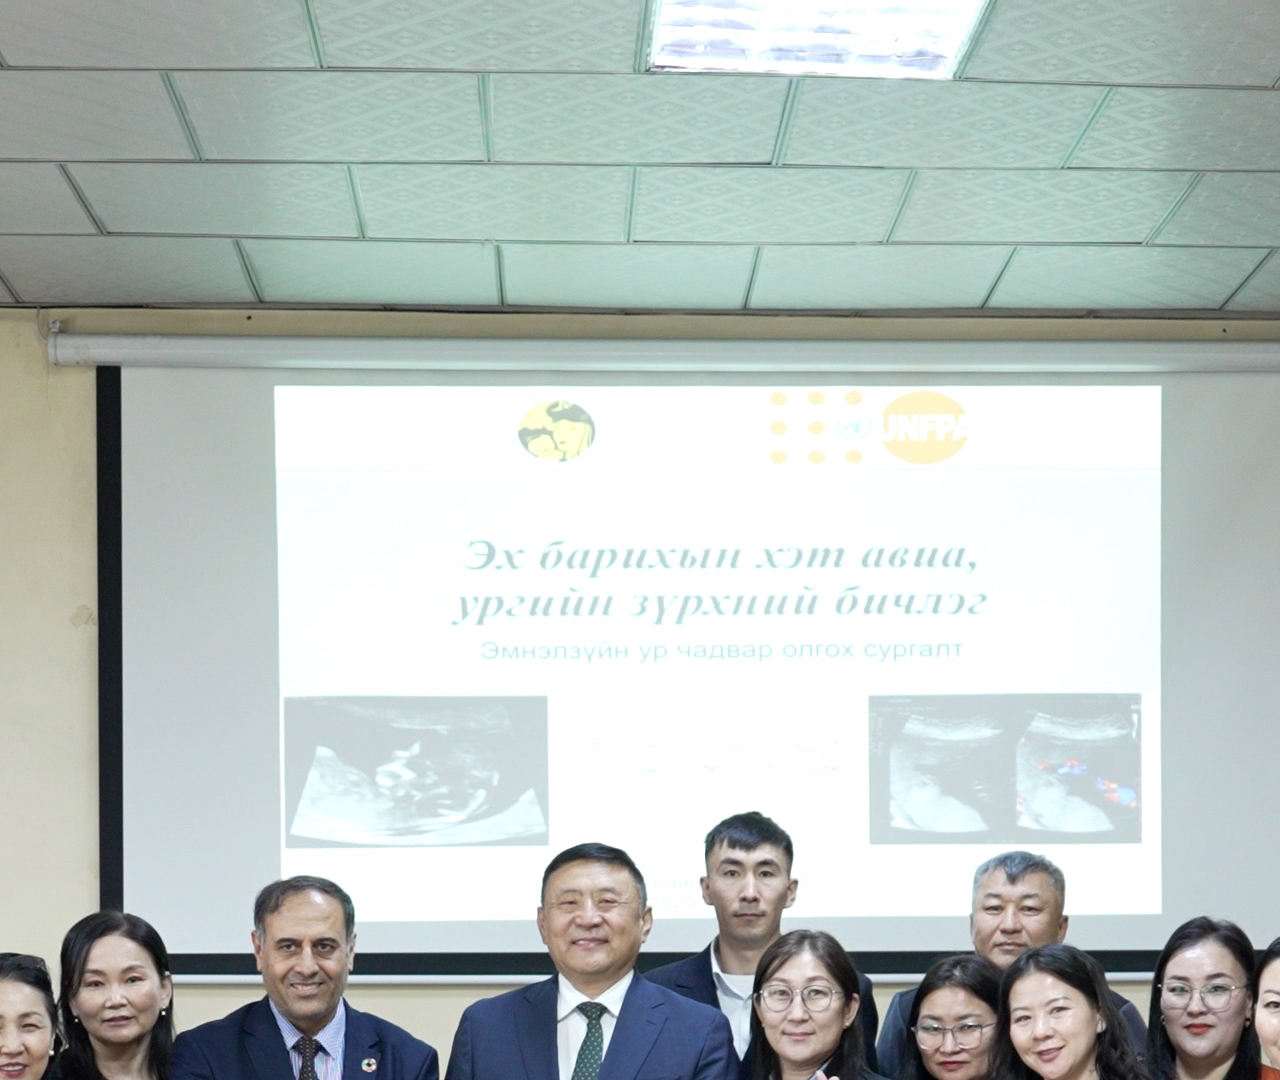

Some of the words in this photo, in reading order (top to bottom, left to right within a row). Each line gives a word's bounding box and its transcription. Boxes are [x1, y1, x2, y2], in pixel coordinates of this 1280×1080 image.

[880, 413, 968, 441] UNFPA
[463, 540, 525, 570] Эх
[540, 540, 742, 578] барихын
[754, 547, 846, 569] хэт
[861, 547, 977, 574] авиа,
[451, 587, 614, 626] ургийн
[629, 585, 820, 625] зүрхний
[834, 585, 988, 616] бичлэг
[480, 641, 629, 663] Эмнэлзүйн
[638, 644, 668, 663] ур
[677, 644, 773, 662] чадвар
[782, 643, 854, 658] олгох
[864, 642, 965, 662] сургалт
